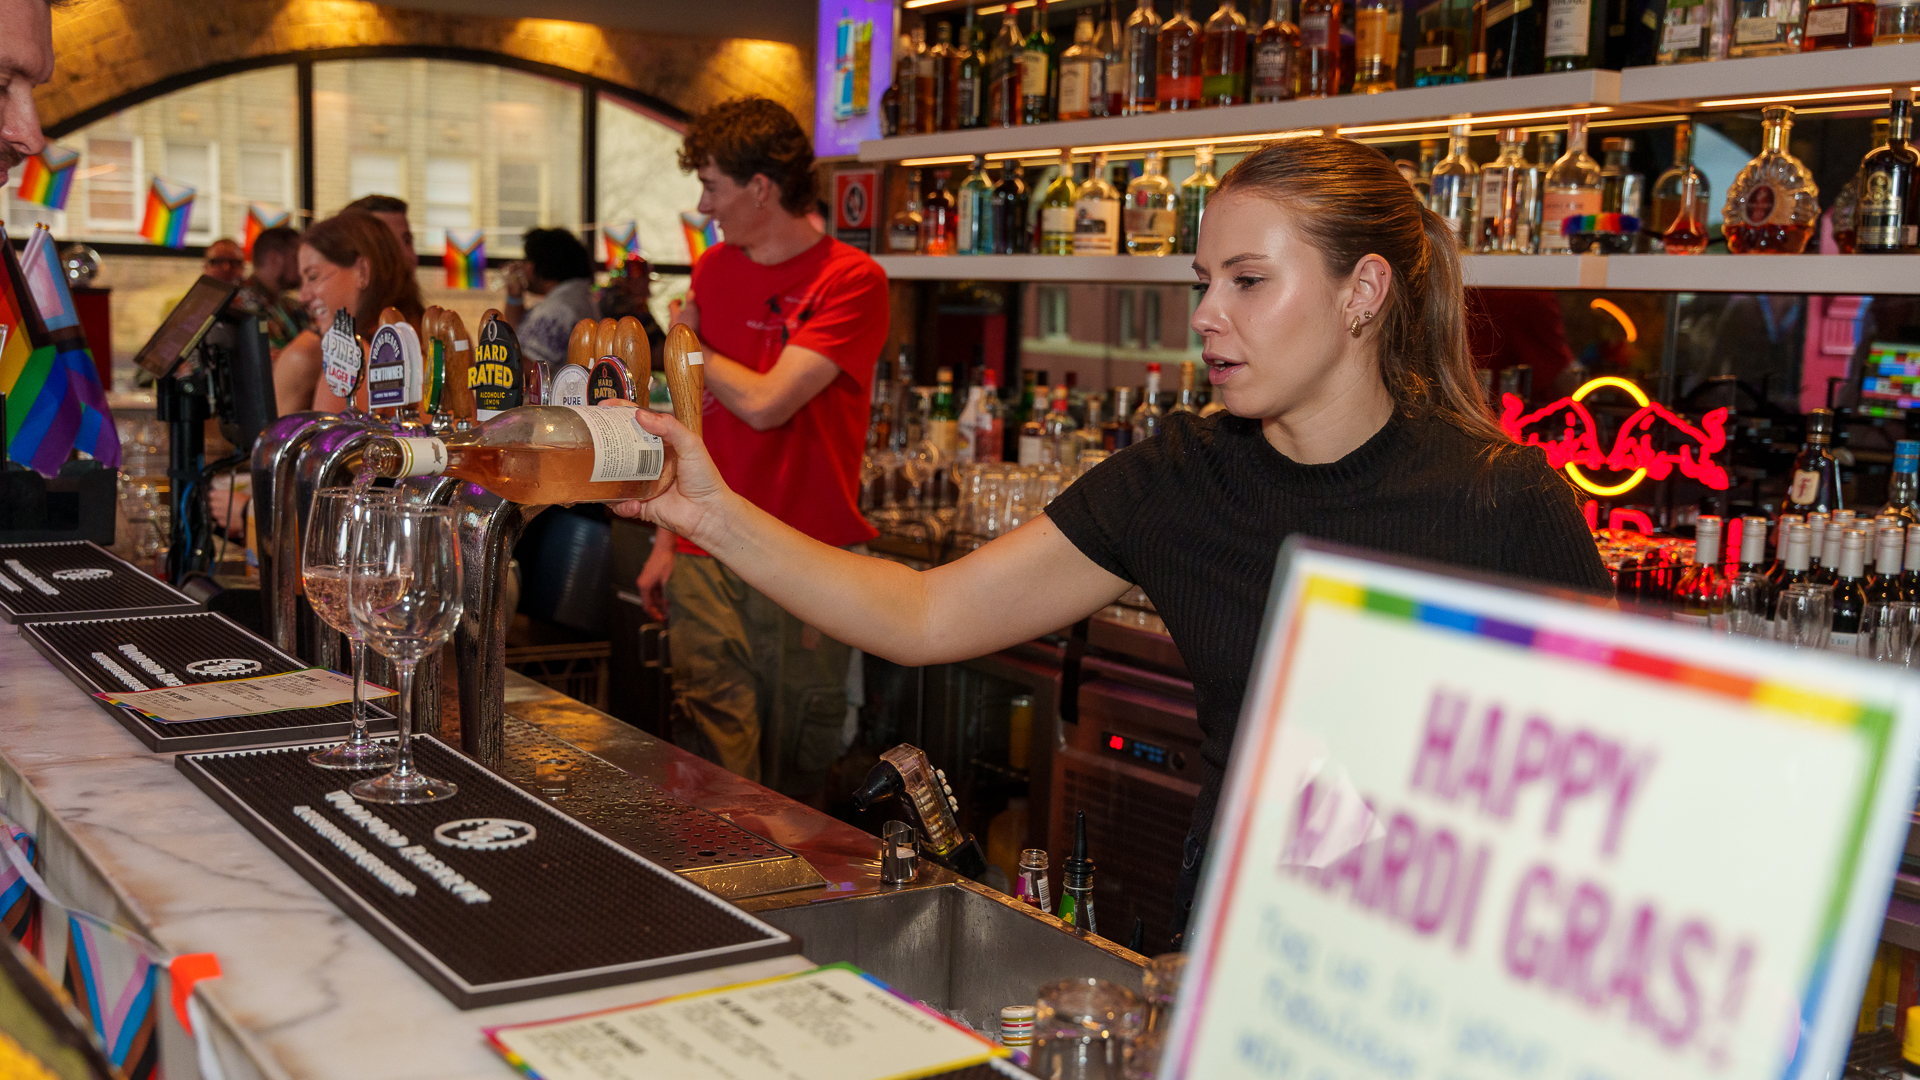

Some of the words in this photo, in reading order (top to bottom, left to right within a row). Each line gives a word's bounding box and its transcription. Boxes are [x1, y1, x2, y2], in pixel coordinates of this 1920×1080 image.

[329, 335, 361, 369] PINES
[475, 343, 508, 363] HARD
[327, 363, 349, 384] LAGER
[369, 364, 404, 383] NEWTOWNER
[466, 362, 514, 390] RATED
[597, 378, 614, 388] HARD
[479, 391, 506, 399] ALCOHOLIC
[562, 396, 582, 406] PURE
[593, 386, 618, 399] RATED
[1408, 684, 1661, 862] HAPPY
[1278, 772, 1492, 955] MARDI
[1502, 861, 1757, 1073] GRAS!
